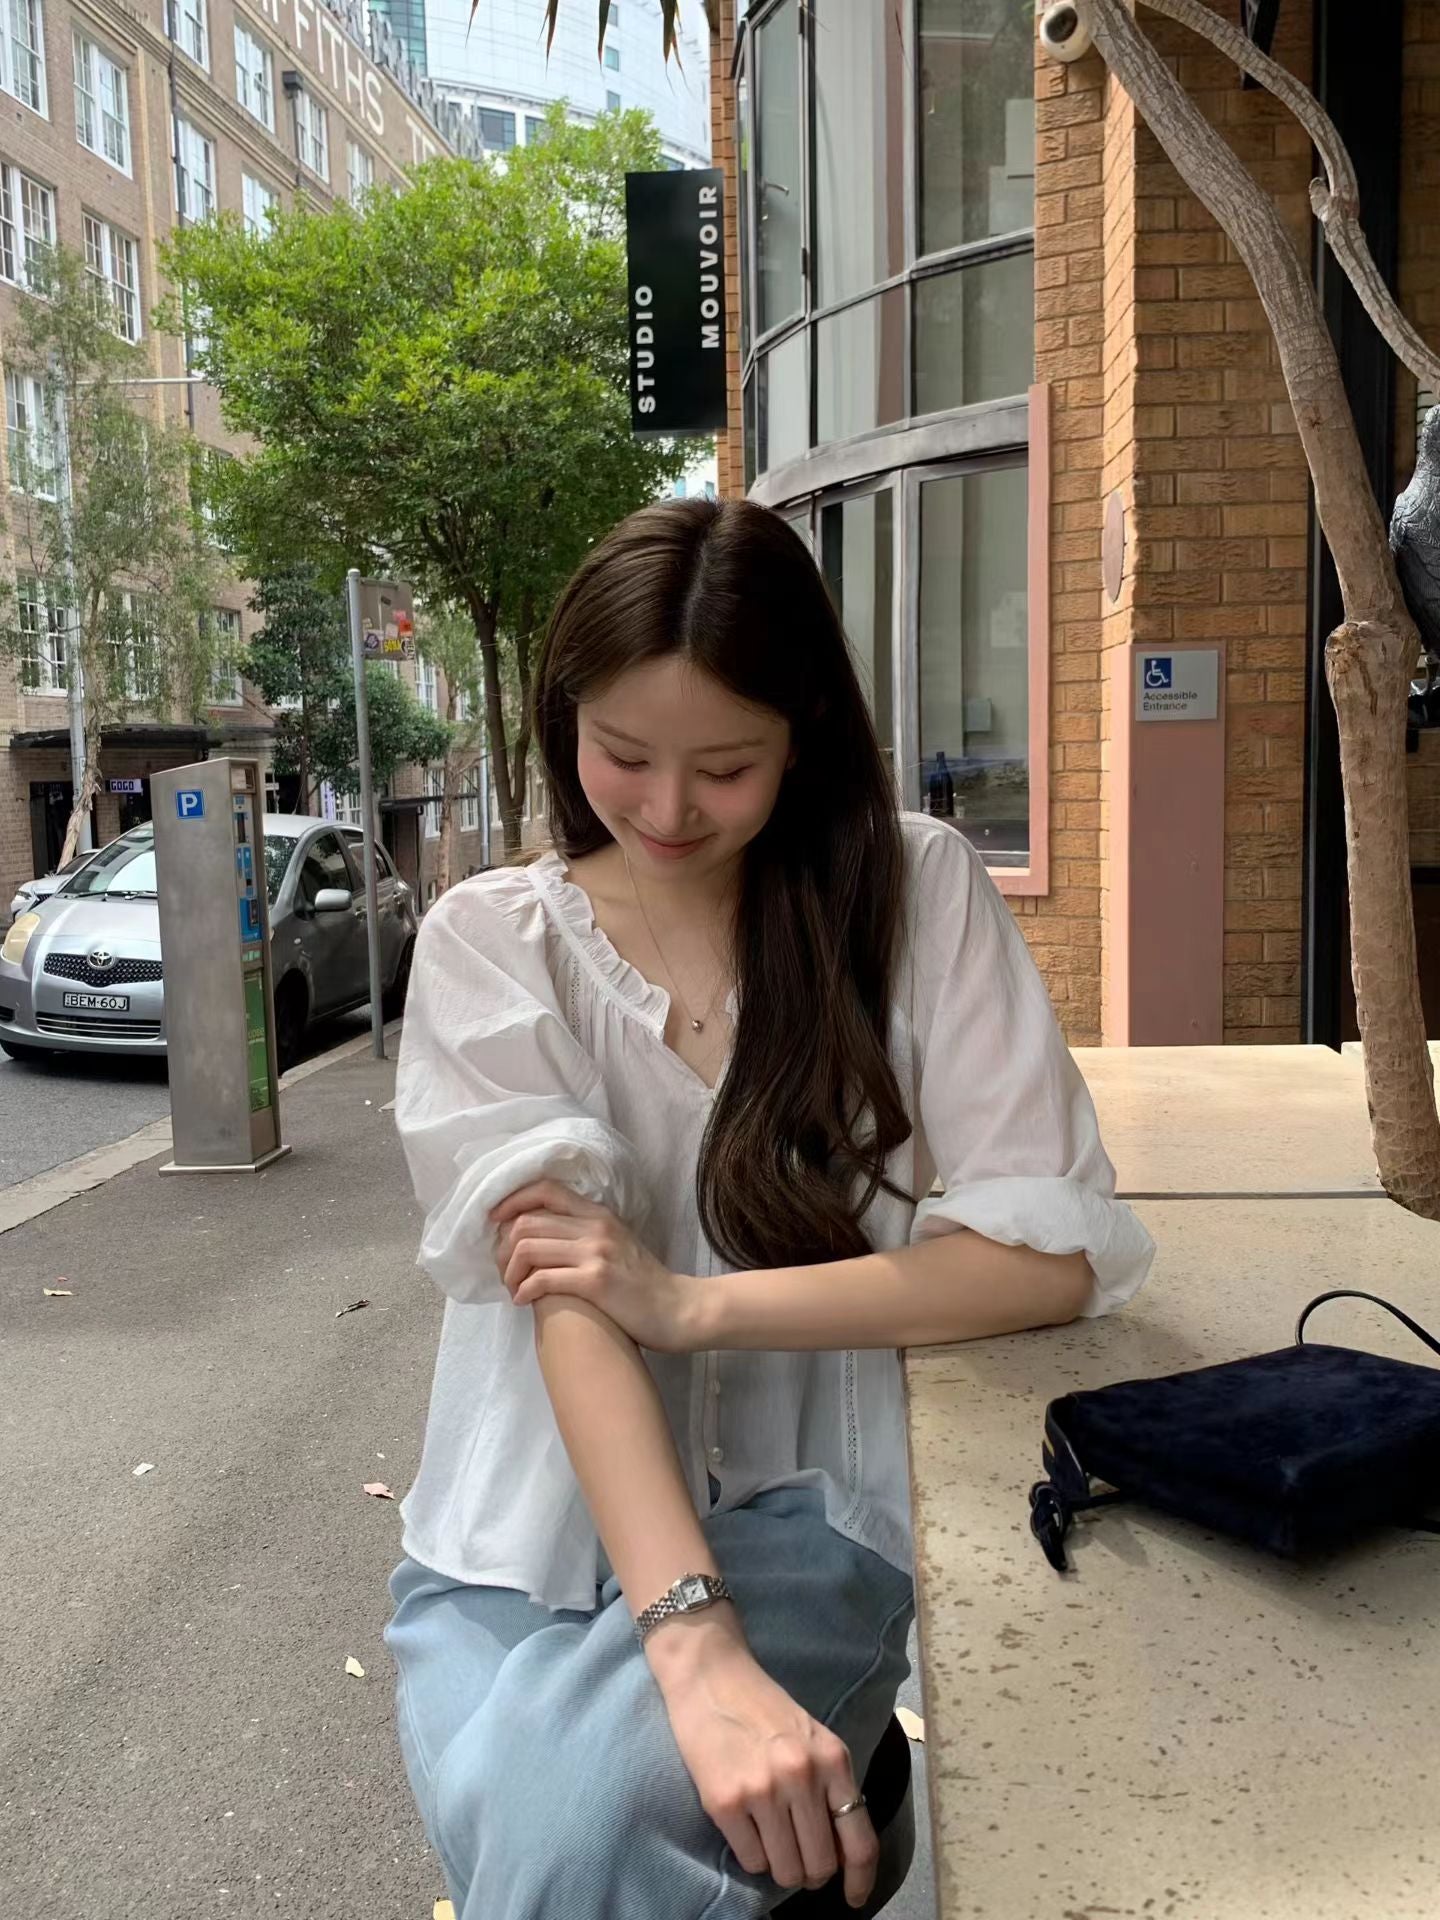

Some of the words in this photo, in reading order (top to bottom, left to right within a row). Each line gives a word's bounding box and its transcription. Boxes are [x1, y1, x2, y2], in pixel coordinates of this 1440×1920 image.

[699, 186, 720, 349] MOUVOIR
[635, 285, 656, 414] STUDIO
[1143, 691, 1198, 701] Accessible
[1143, 702, 1187, 711] Entrance
[181, 793, 198, 816] P
